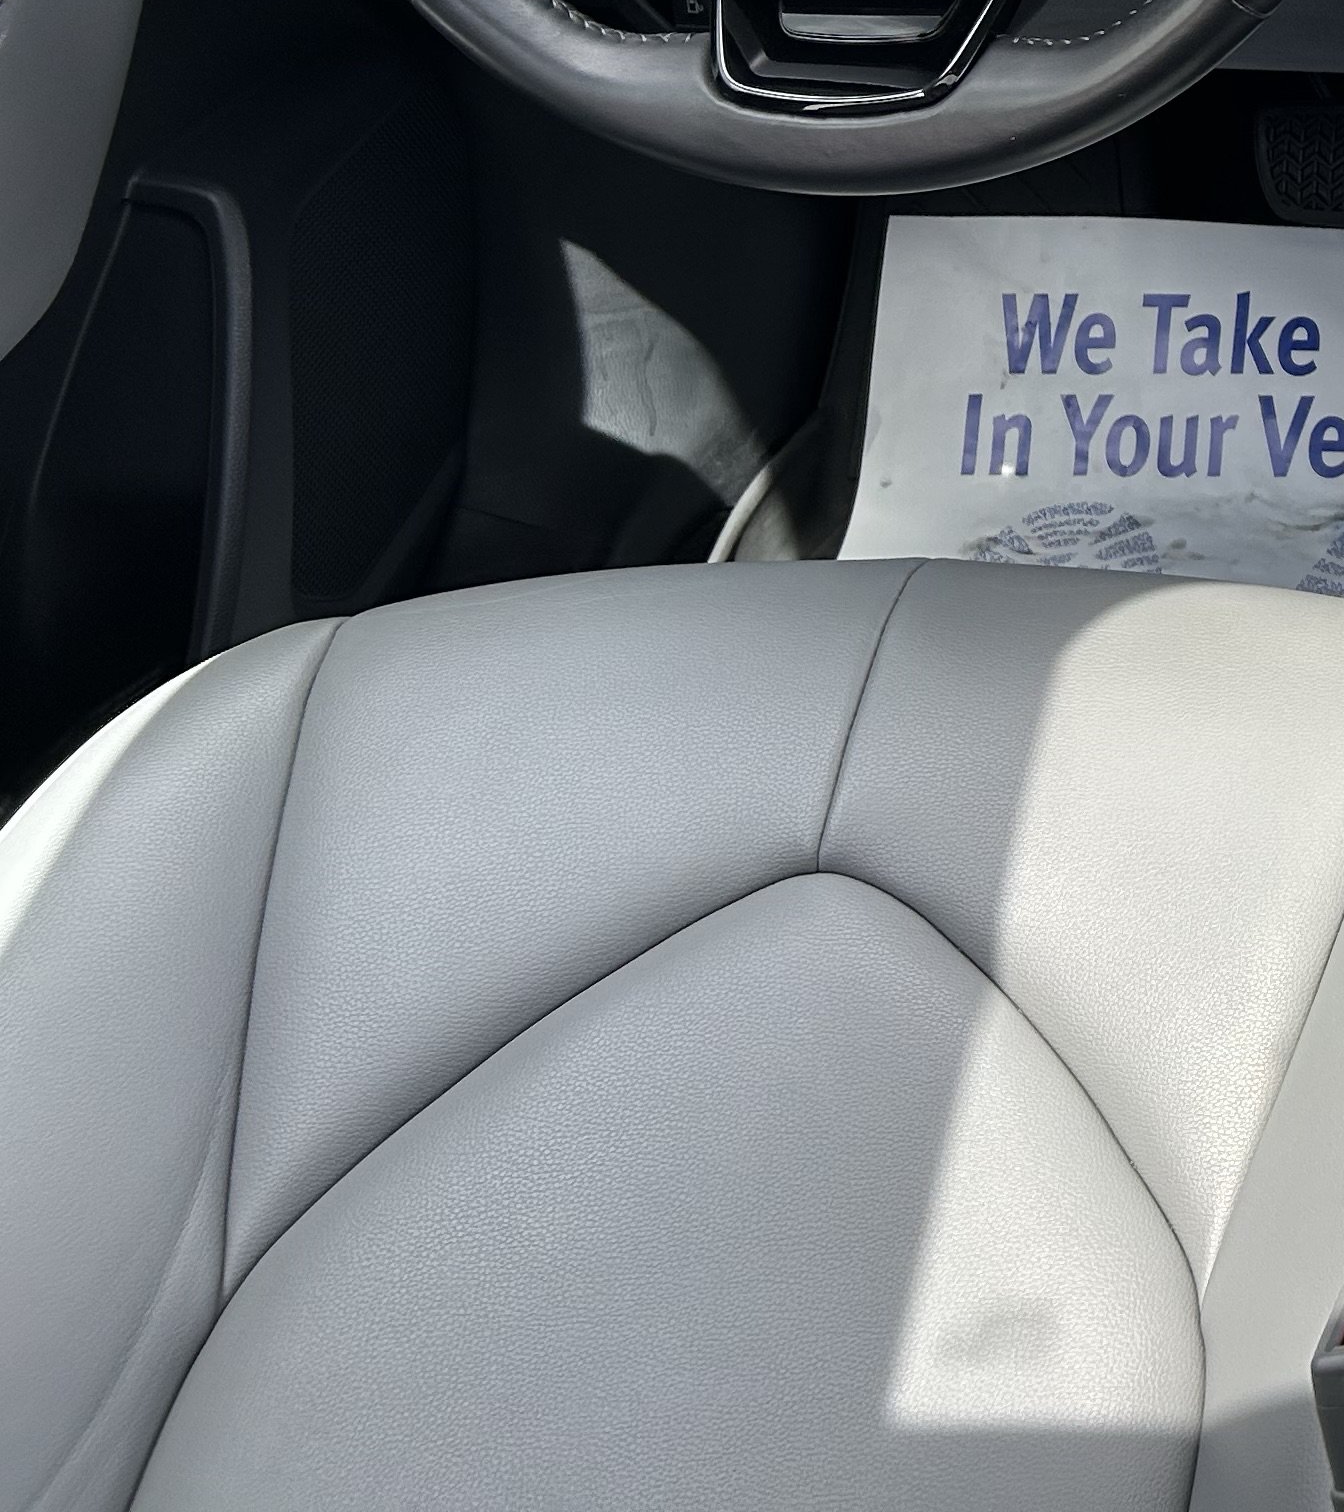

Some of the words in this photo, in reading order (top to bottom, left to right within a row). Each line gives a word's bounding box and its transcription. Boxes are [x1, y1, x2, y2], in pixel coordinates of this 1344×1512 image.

[1002, 293, 1117, 377] We
[1142, 292, 1319, 377] Take
[960, 393, 1032, 477] In
[1061, 393, 1240, 478] Your
